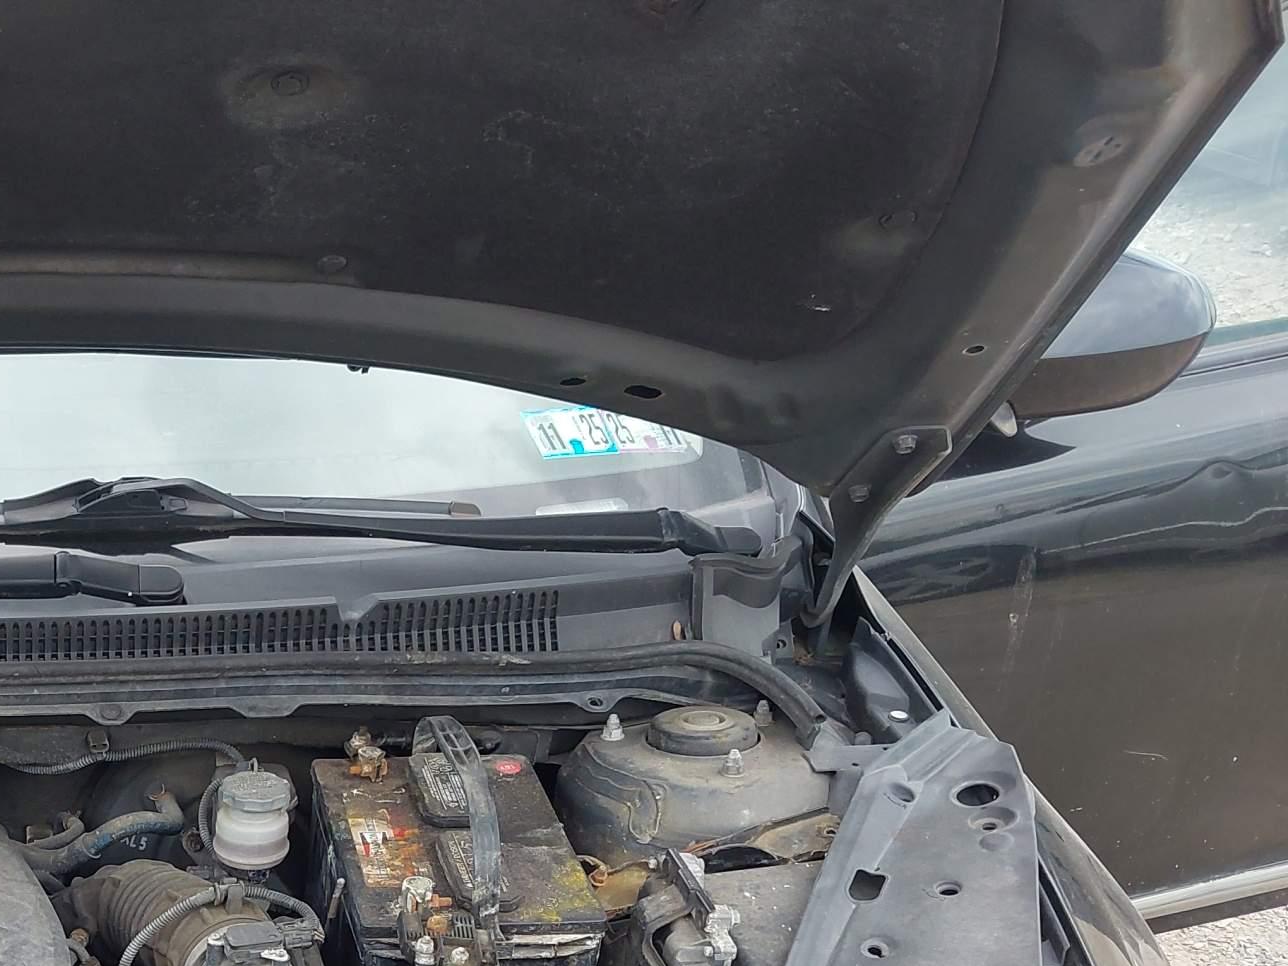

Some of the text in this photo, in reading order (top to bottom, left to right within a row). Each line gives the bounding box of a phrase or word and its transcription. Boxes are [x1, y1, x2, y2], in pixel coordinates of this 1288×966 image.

[537, 413, 609, 451] 11 25
[607, 413, 636, 444] 25
